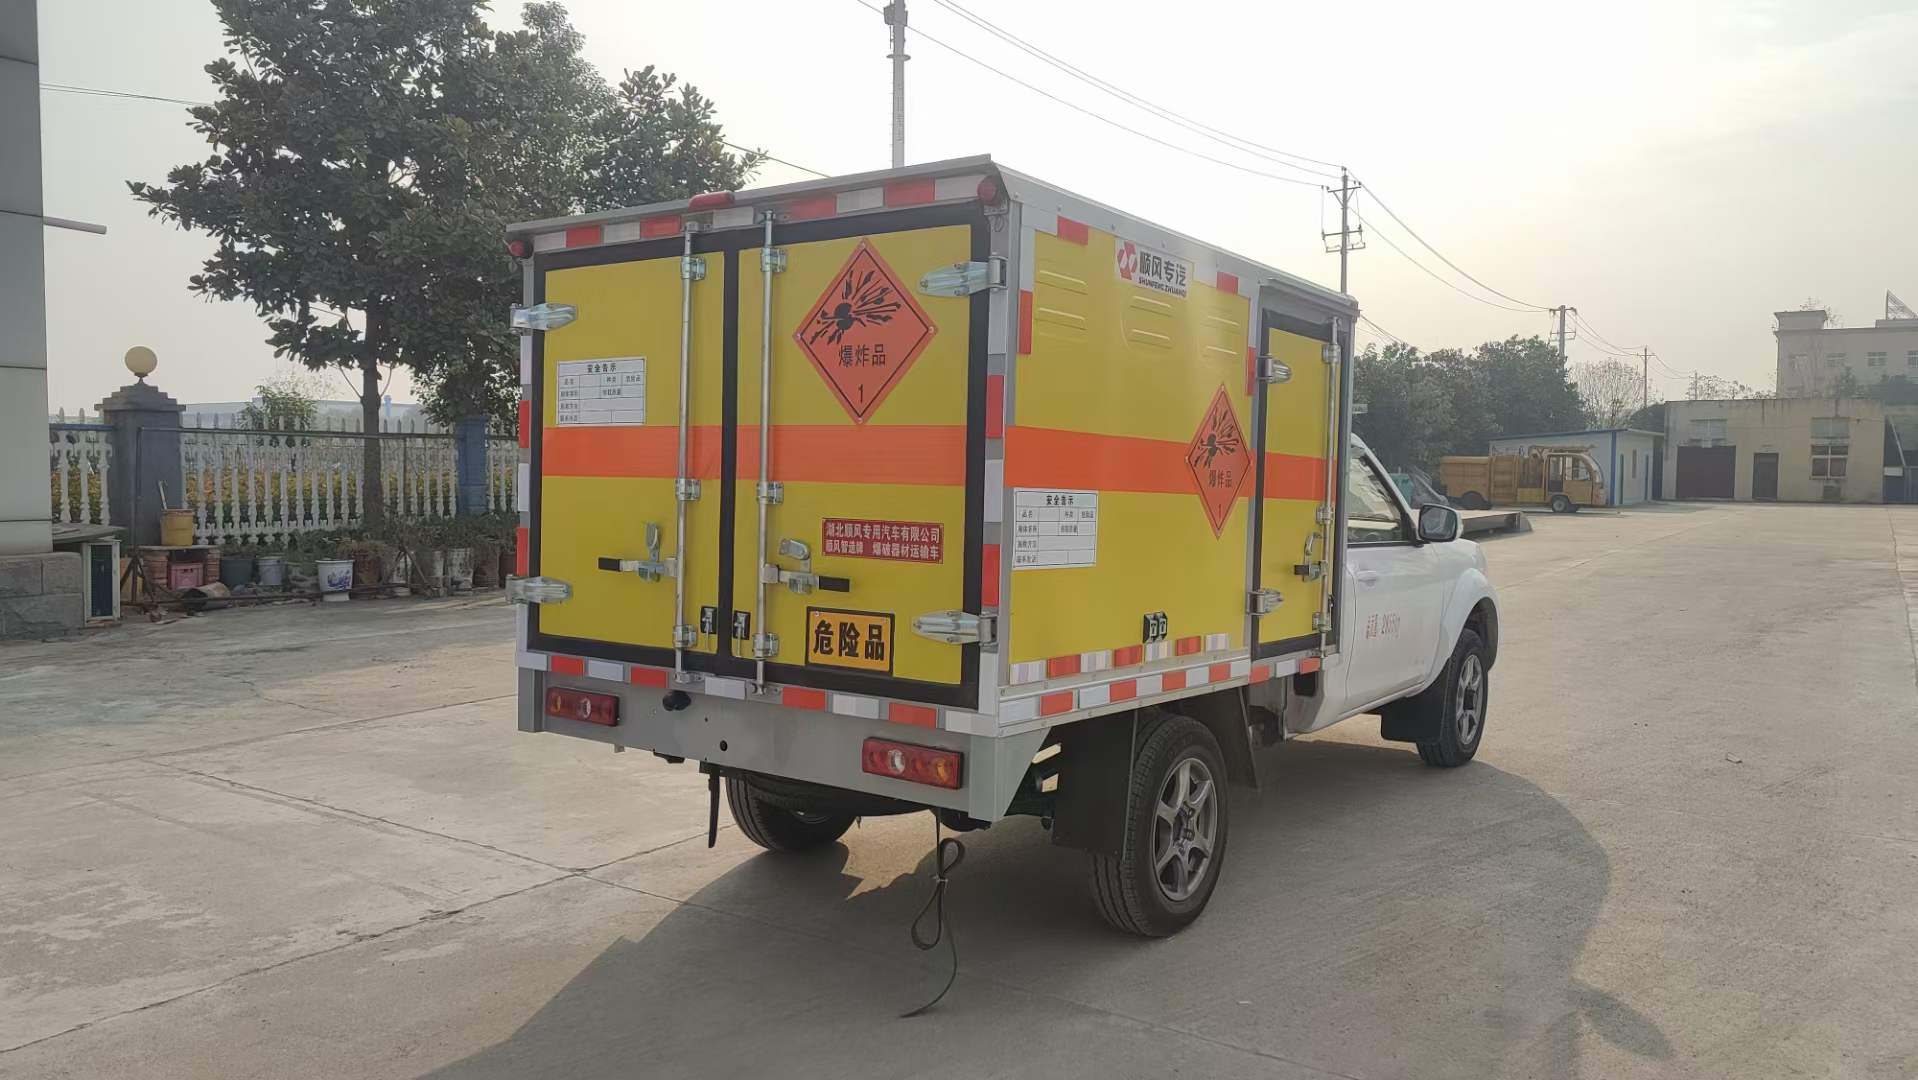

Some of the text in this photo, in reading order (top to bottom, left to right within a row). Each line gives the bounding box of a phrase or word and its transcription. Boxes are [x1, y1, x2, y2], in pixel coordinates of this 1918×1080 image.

[1139, 250, 1187, 288] 顺风专汽
[838, 343, 887, 369] 爆炸品
[857, 383, 864, 404] 1
[1208, 469, 1233, 489] 爆炸品
[1045, 494, 1075, 507] 安全告示
[825, 521, 941, 545] 湖北顺风专用汽车有限公司
[872, 541, 940, 561] 爆破器材运输车
[813, 618, 886, 662] 危险品
